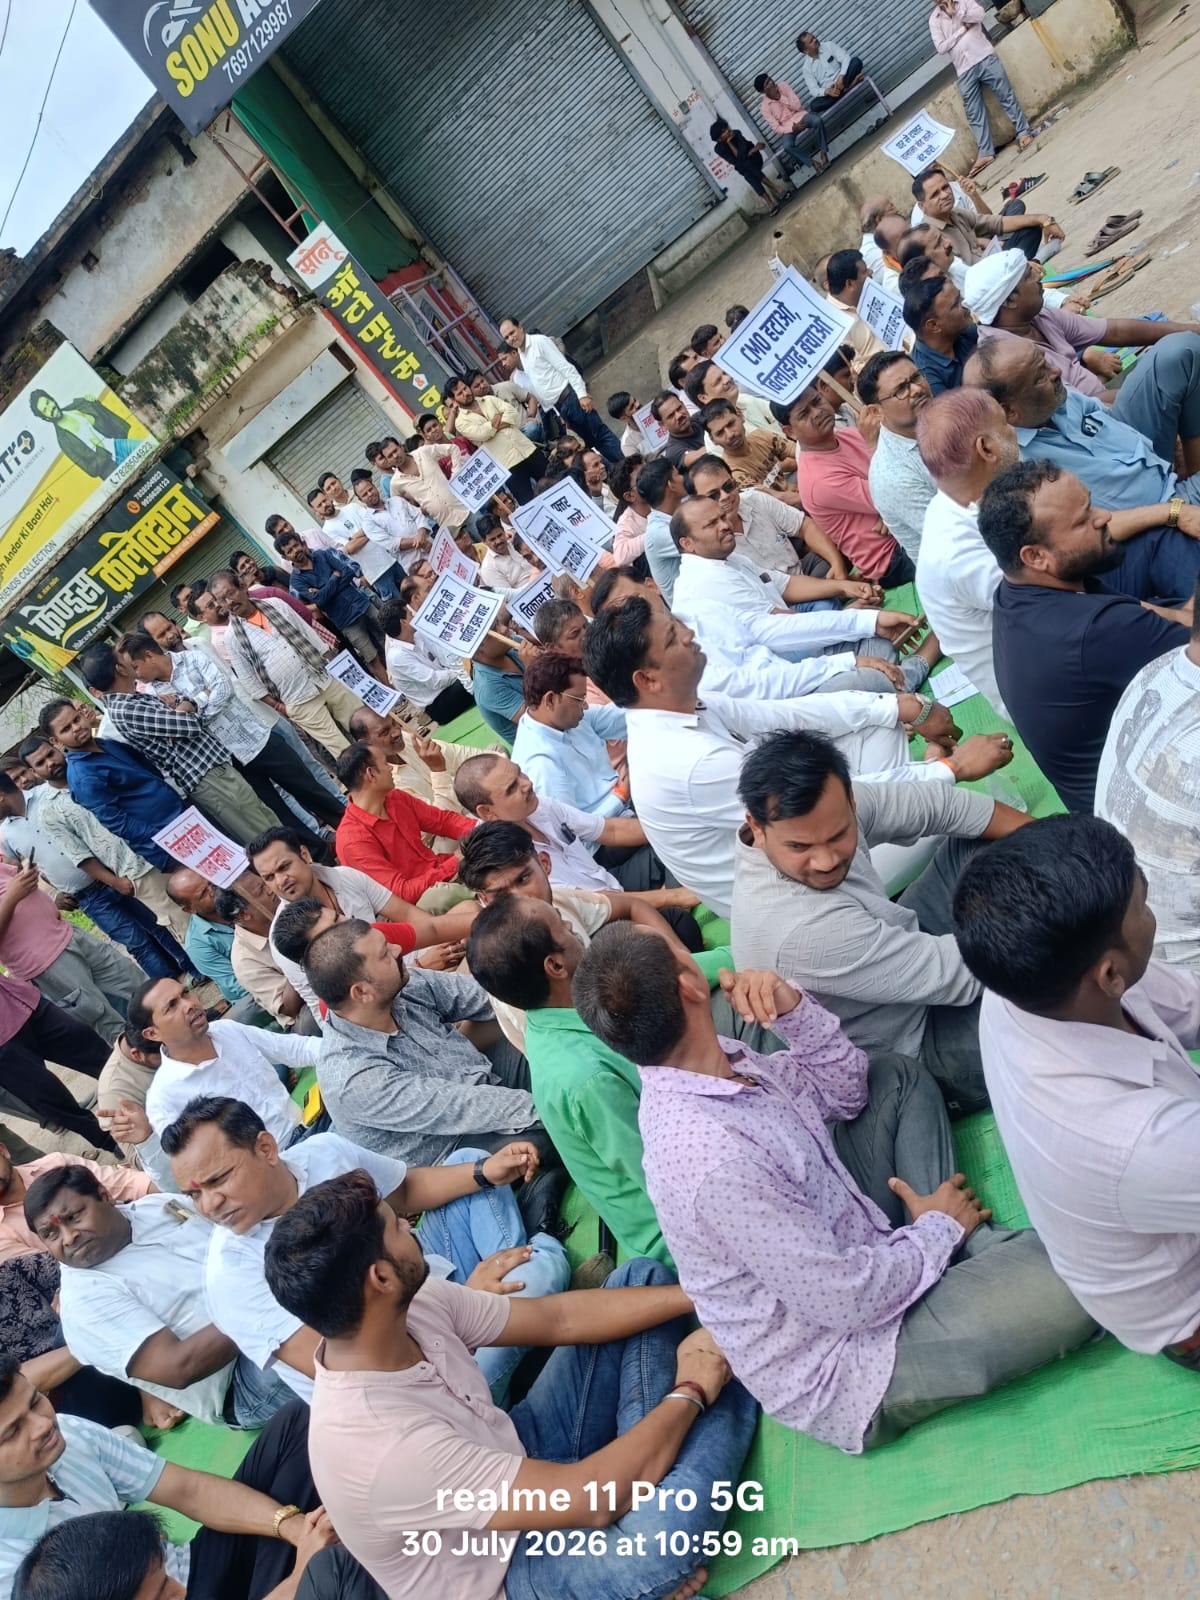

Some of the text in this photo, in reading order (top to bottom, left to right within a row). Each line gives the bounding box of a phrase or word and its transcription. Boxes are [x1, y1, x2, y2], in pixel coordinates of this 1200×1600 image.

[166, 0, 239, 97] SONU
[222, 0, 292, 83] 7697129987
[295, 237, 346, 274] सोनू
[326, 261, 374, 323] ऑटो
[740, 332, 771, 365] CMO
[759, 300, 800, 342] हटाओ,
[756, 314, 833, 394] बिलाईगढ़ बचाओ
[3, 540, 23, 561] Andar
[19, 527, 30, 539] Ki
[26, 510, 43, 530] Baat
[40, 493, 54, 509] Hai
[19, 540, 56, 580] COLLECTION
[88, 483, 205, 592] कलेक्शन
[441, 589, 455, 601] की
[475, 604, 490, 616] बार
[519, 592, 546, 619] विकास
